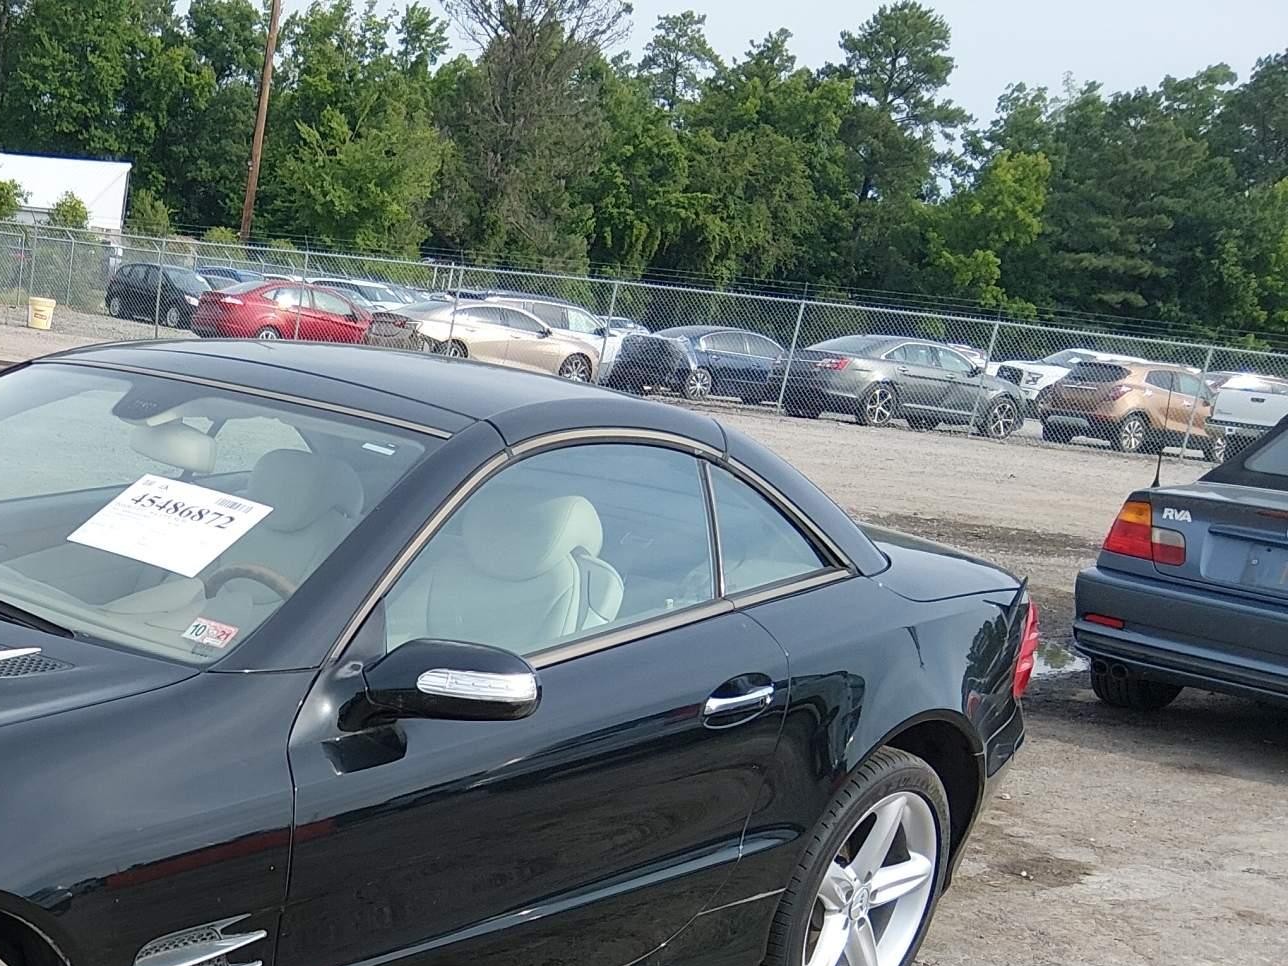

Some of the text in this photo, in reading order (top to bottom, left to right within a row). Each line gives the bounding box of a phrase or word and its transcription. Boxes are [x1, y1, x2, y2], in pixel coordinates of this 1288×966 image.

[131, 492, 236, 530] 45486872
[1162, 507, 1192, 523] RVA
[190, 623, 232, 641] 10 21
